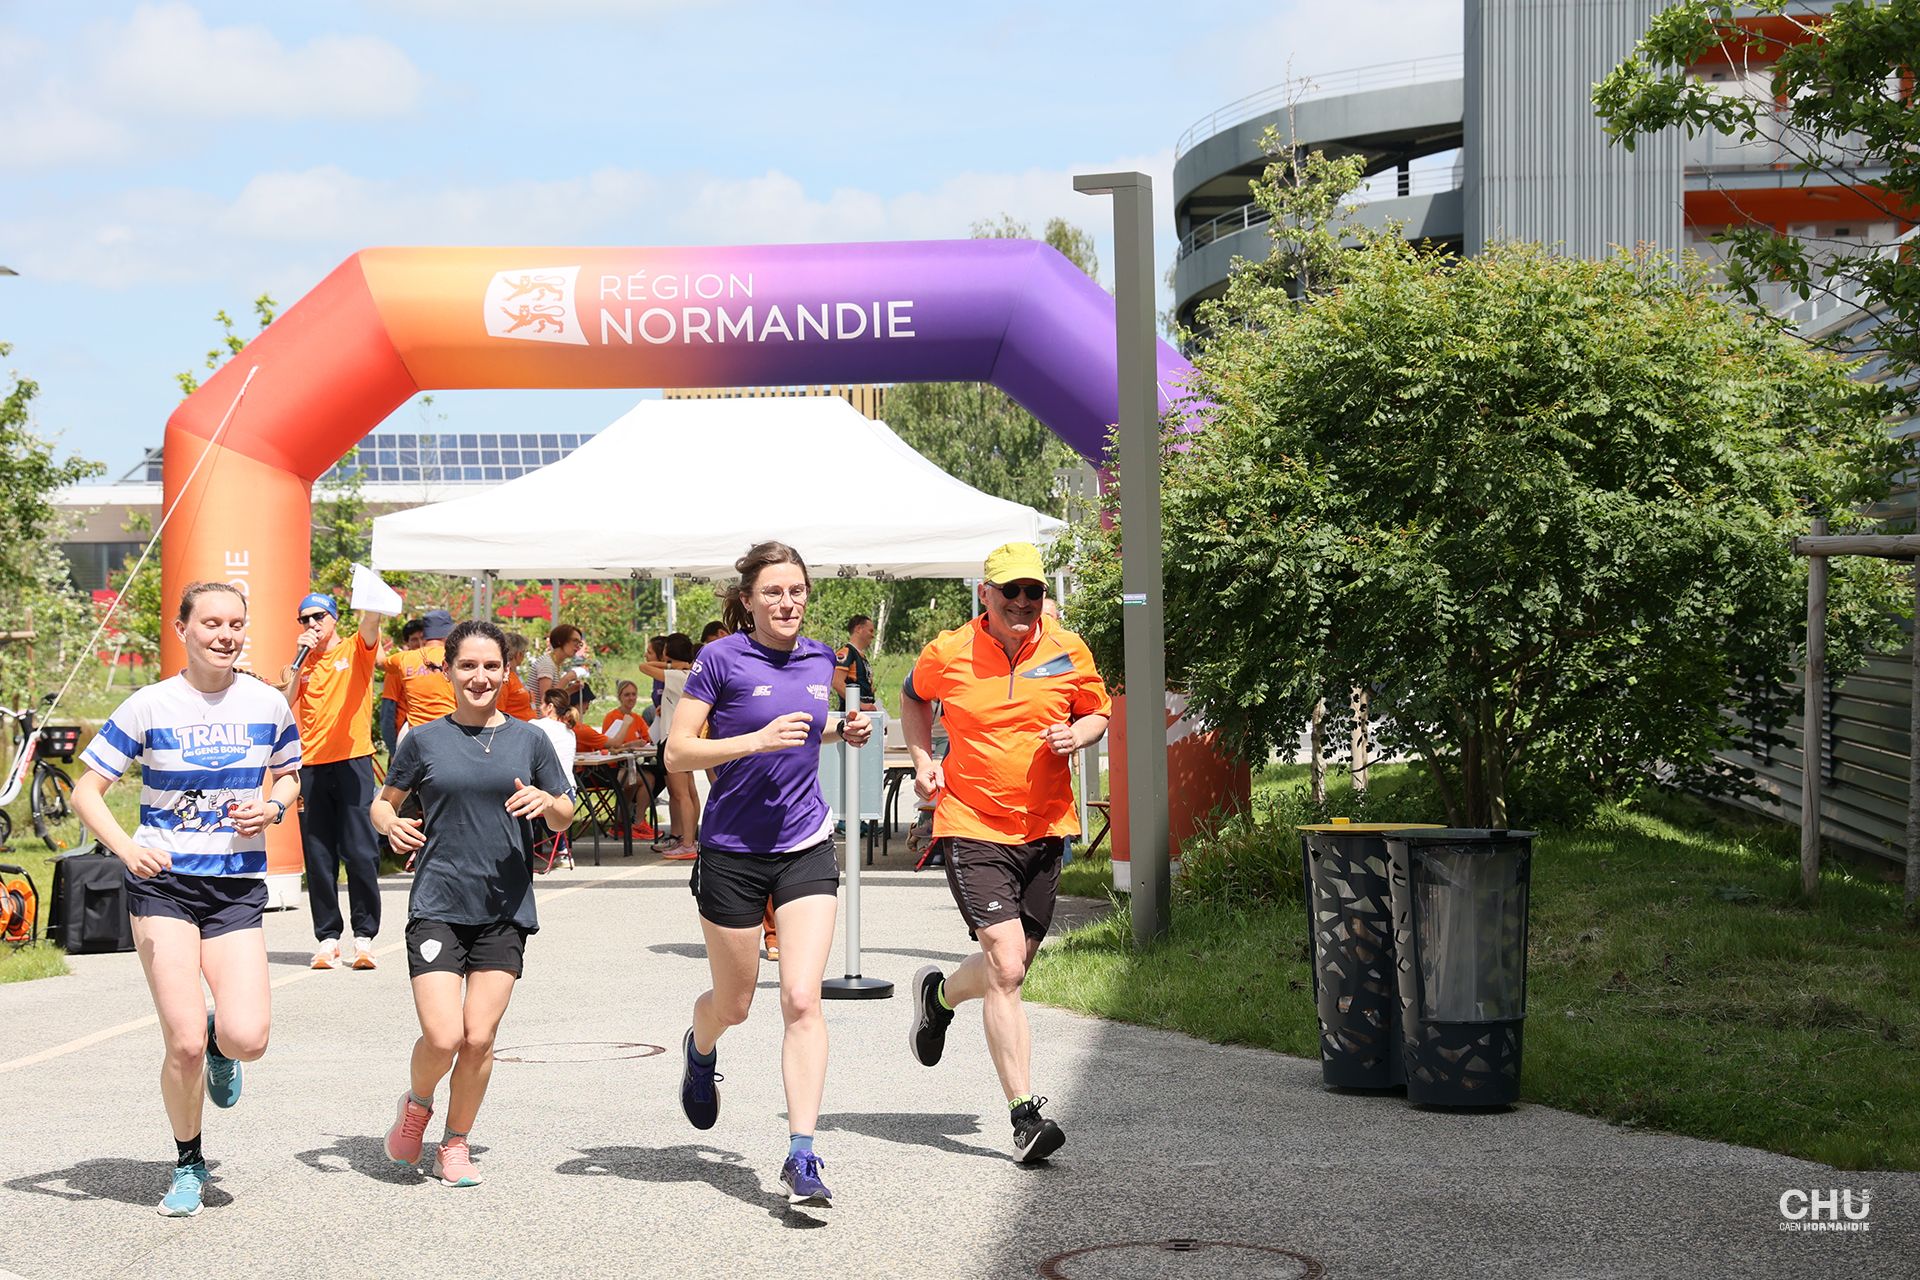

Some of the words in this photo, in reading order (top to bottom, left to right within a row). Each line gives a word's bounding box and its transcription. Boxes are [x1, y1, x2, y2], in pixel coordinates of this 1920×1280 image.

[600, 270, 753, 300] RÉGION
[600, 300, 915, 345] NORMANDIE
[176, 724, 251, 749] TRAIL
[195, 746, 219, 757] GENS
[220, 745, 246, 754] BONS
